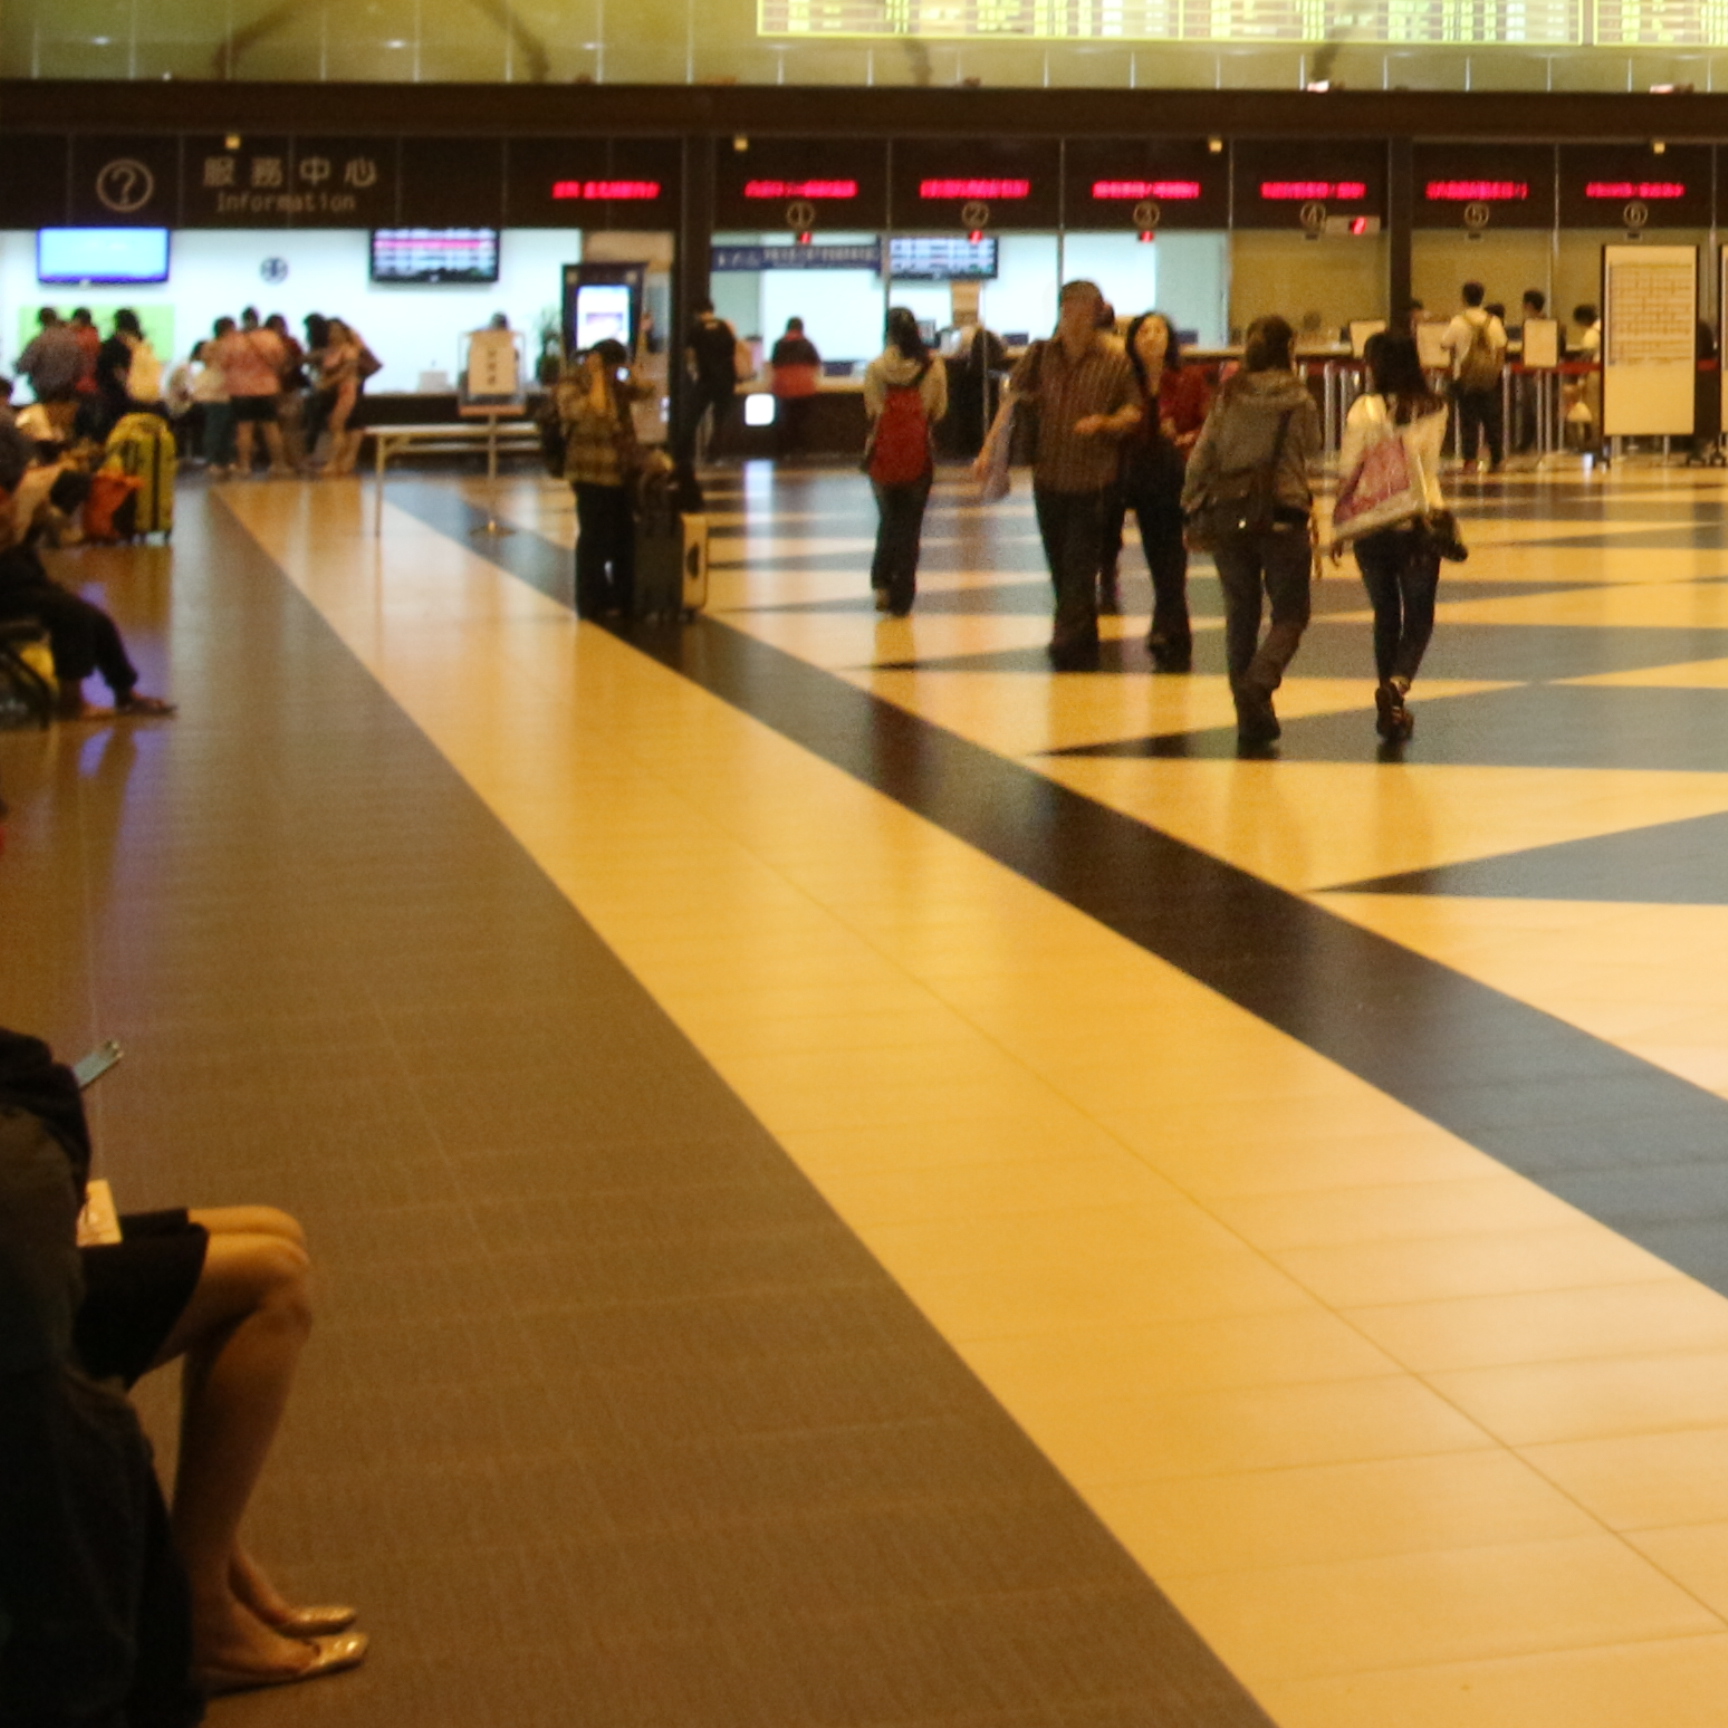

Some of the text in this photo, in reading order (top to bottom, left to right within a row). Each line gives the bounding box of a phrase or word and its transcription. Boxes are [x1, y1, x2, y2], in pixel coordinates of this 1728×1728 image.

[203, 156, 378, 188] 服務中心
[217, 192, 357, 213] Information
